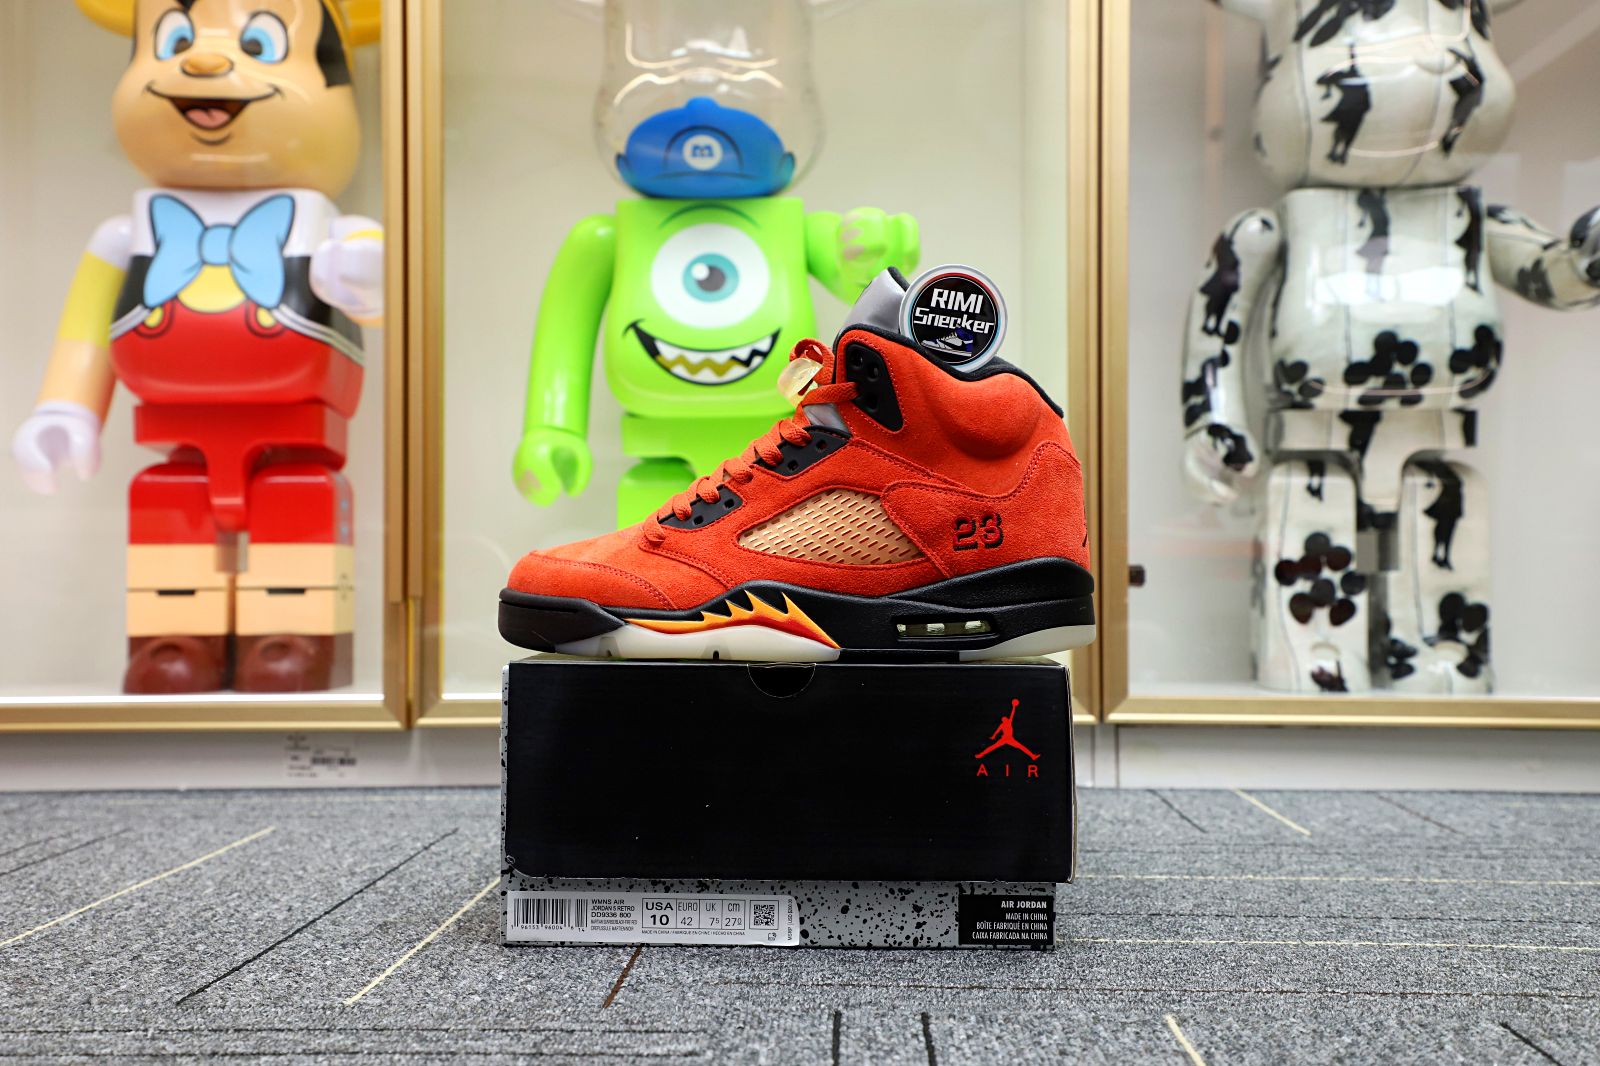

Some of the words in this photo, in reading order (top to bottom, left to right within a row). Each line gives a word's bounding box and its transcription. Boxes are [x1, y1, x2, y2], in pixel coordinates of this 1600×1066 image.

[930, 287, 984, 314] RIMI
[913, 306, 995, 335] Sneaker
[953, 513, 1004, 551] 23
[645, 901, 674, 911] USA
[677, 902, 698, 912] EURO
[705, 902, 717, 912] UK
[1001, 900, 1015, 909] AIR
[1016, 900, 1047, 909] JORDAN
[650, 914, 670, 926] 10
[680, 916, 693, 926] 42
[1005, 912, 1022, 920] MADE
[1022, 912, 1029, 920] IN
[1030, 912, 1048, 921] CHINA
[1021, 922, 1030, 930] EN
[1030, 922, 1048, 930] CHINA
[972, 931, 989, 940] CAIXA
[989, 931, 1021, 940] FABRICADA
[1021, 932, 1030, 940] NA
[1030, 932, 1048, 940] CHINA
